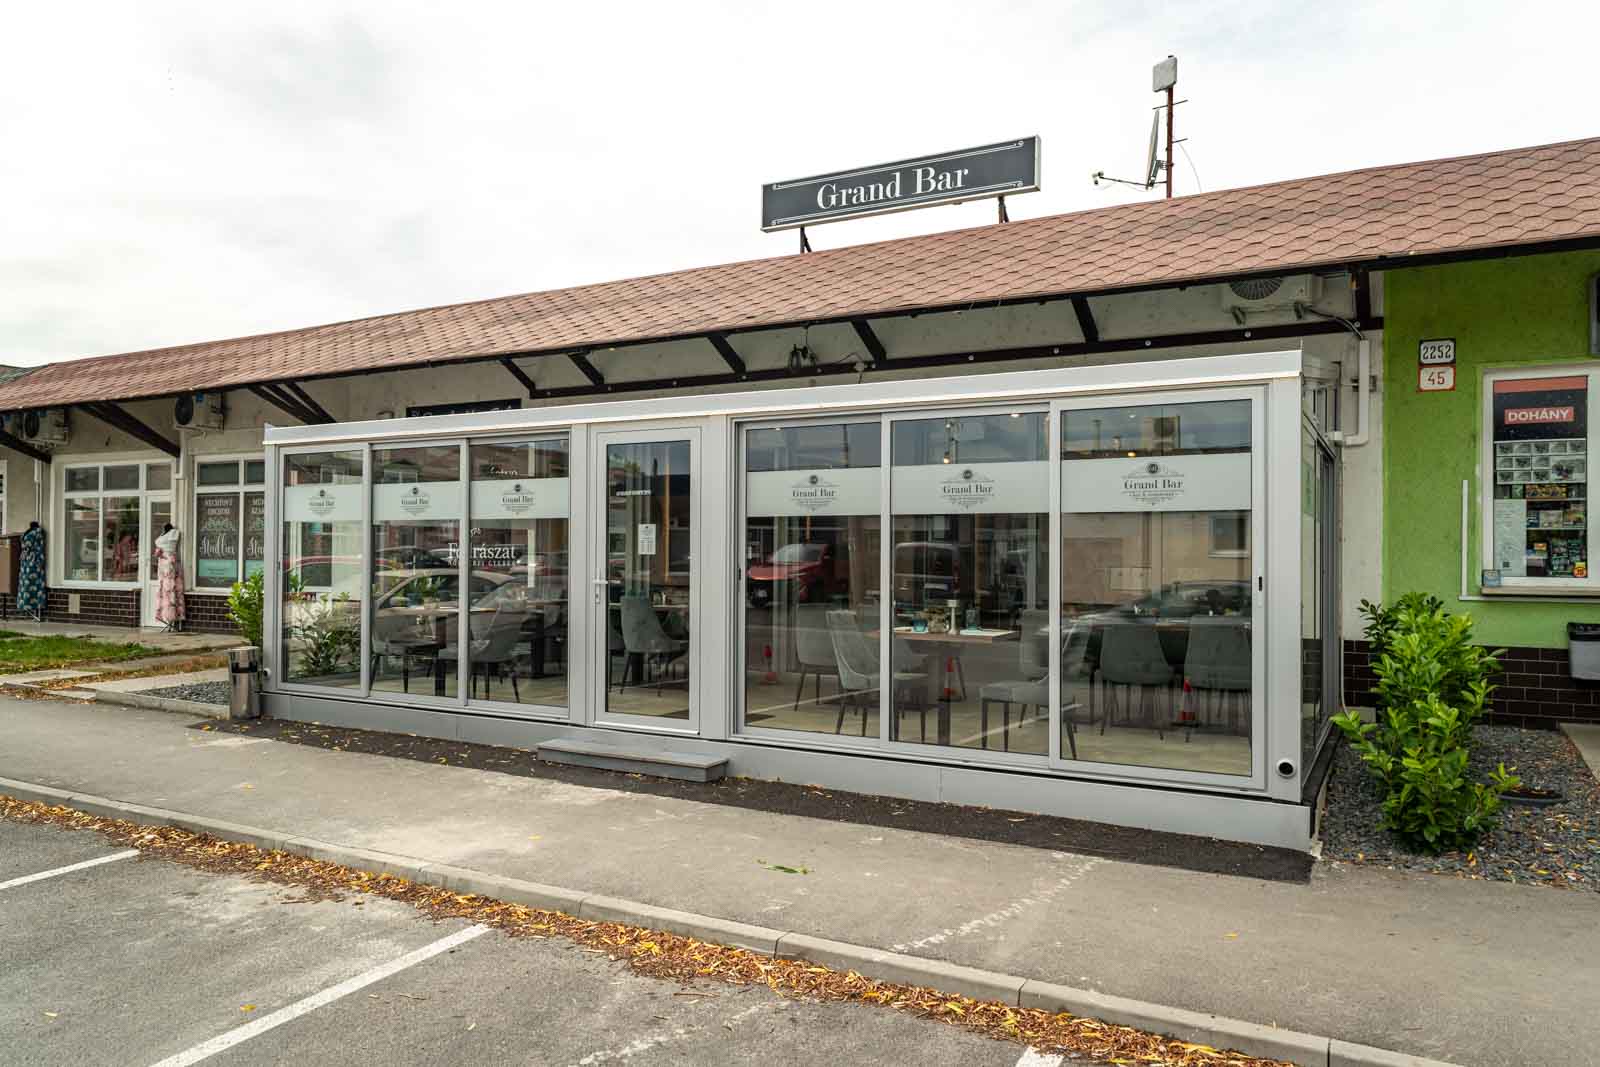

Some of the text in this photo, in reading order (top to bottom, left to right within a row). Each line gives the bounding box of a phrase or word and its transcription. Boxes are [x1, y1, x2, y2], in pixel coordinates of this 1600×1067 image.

[817, 166, 969, 210] Grand Bar
[1423, 344, 1451, 360] 2252
[1427, 371, 1446, 385] 45
[1508, 407, 1569, 422] DOHÁNY
[943, 483, 992, 494] Grand Bar
[1124, 479, 1184, 489] Grand Bar
[792, 487, 837, 497] Grand Bar
[447, 542, 516, 559] Frászat
